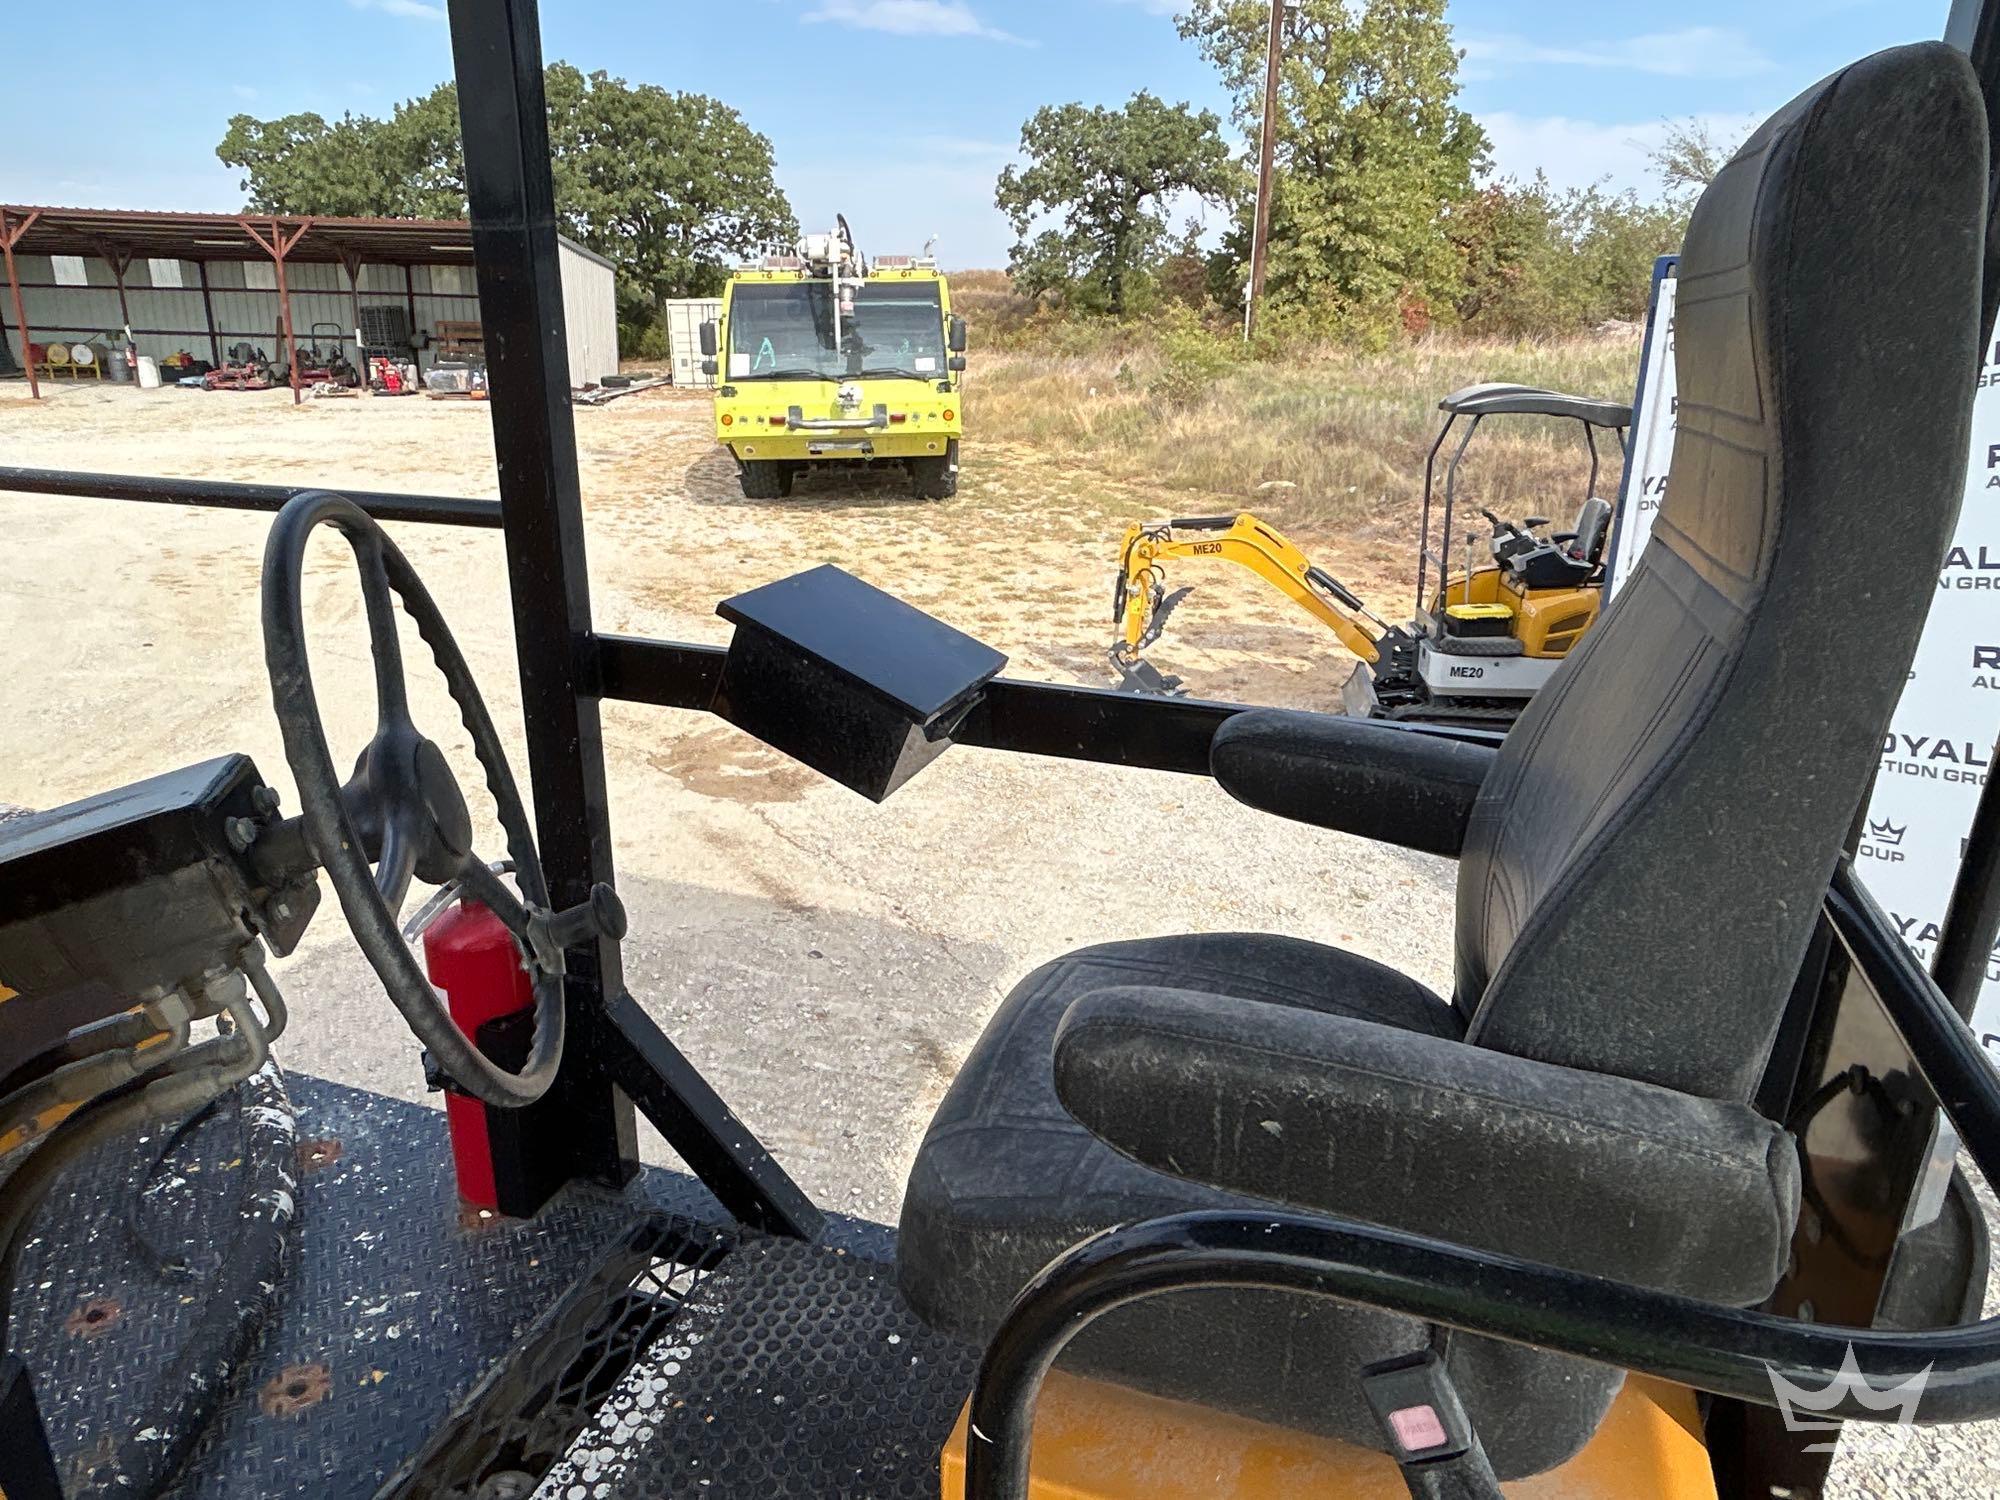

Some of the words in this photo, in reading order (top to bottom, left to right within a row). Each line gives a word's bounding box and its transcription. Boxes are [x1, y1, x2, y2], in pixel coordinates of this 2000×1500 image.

[753, 337, 776, 370] A
[1193, 543, 1222, 555] ME20
[1450, 666, 1484, 679] ME20
[1882, 732, 1988, 767] OYAL
[1879, 759, 1938, 779] TION
[1859, 844, 1905, 863] OUP
